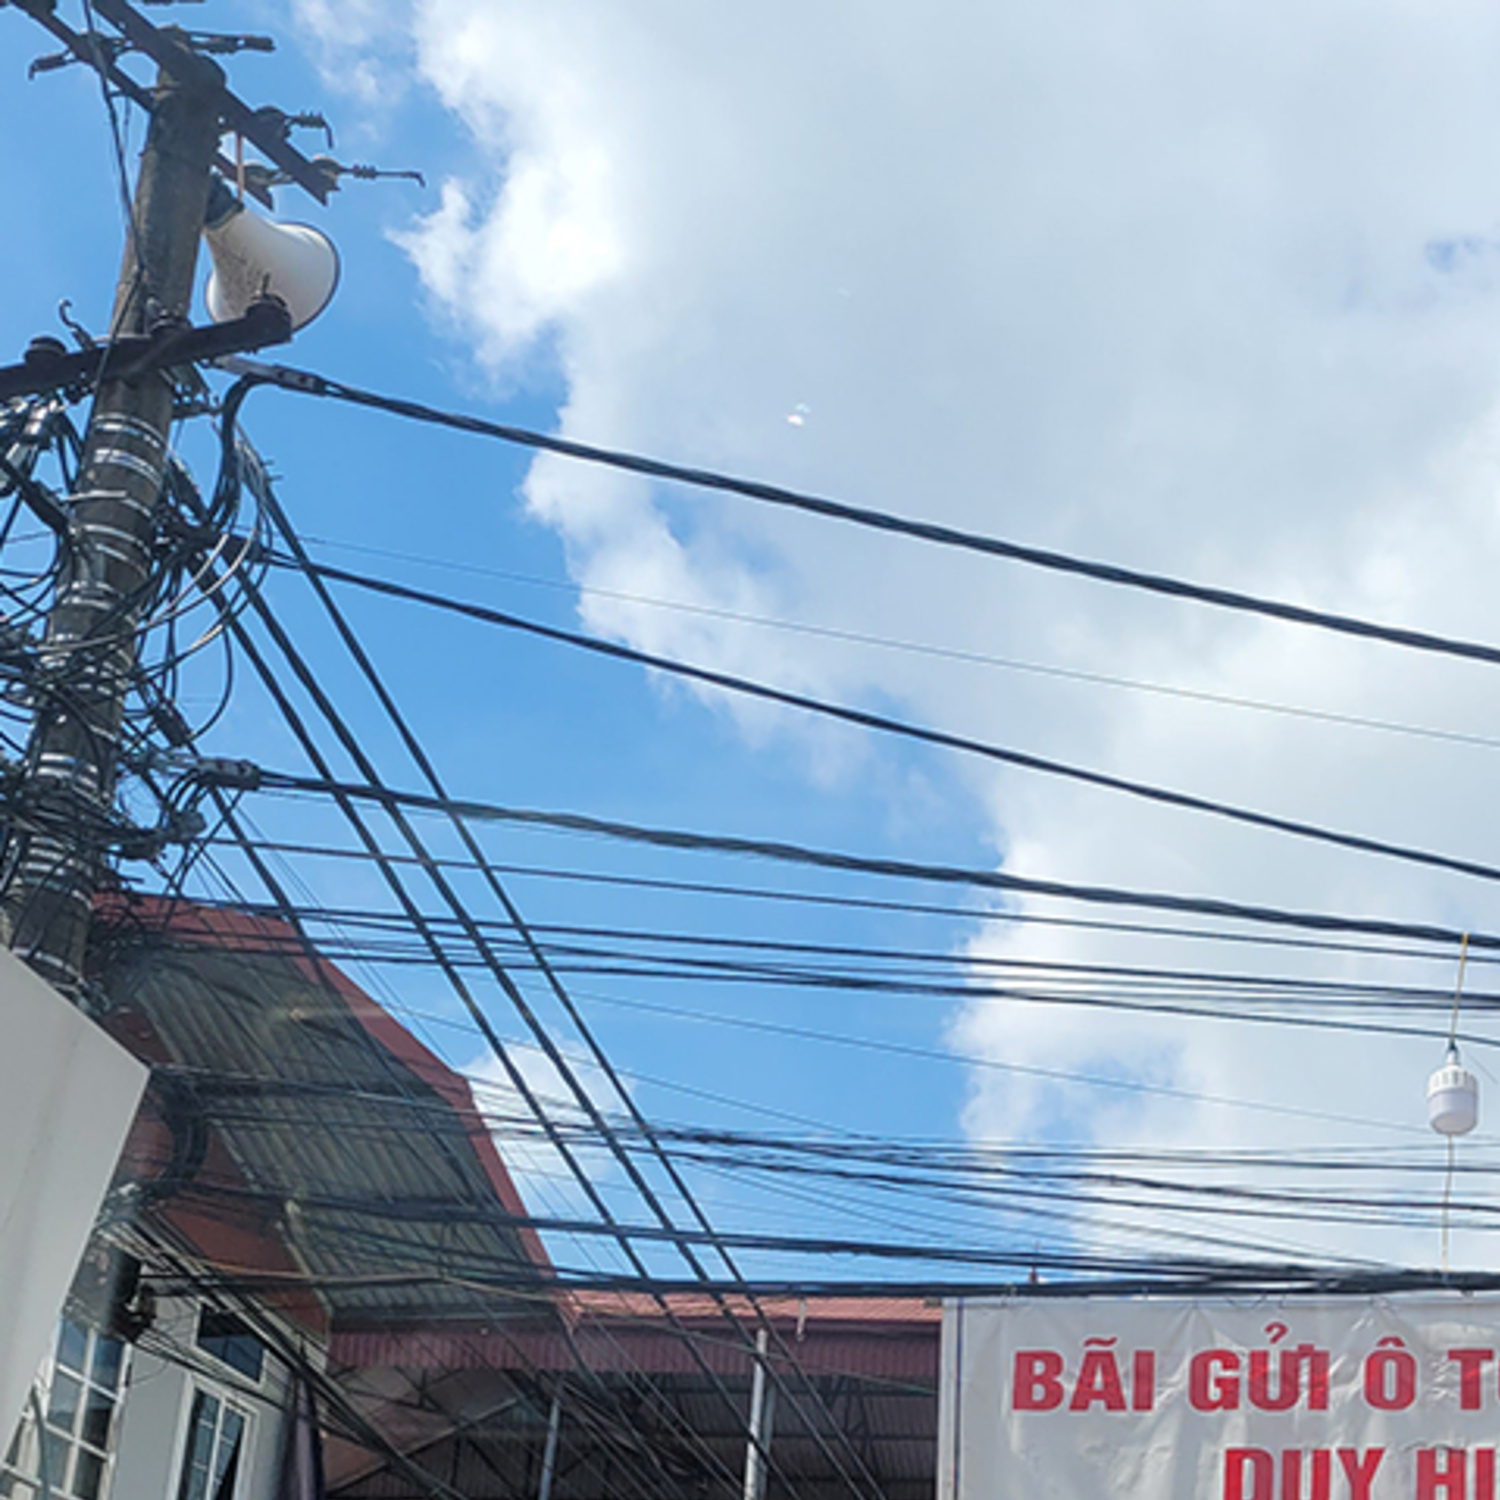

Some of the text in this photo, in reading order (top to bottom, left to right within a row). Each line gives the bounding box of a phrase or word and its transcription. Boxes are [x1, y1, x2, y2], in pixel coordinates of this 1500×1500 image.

[1011, 1337, 1155, 1411] BÃI
[1188, 1322, 1330, 1412] GỬI
[1364, 1335, 1417, 1411] Ô
